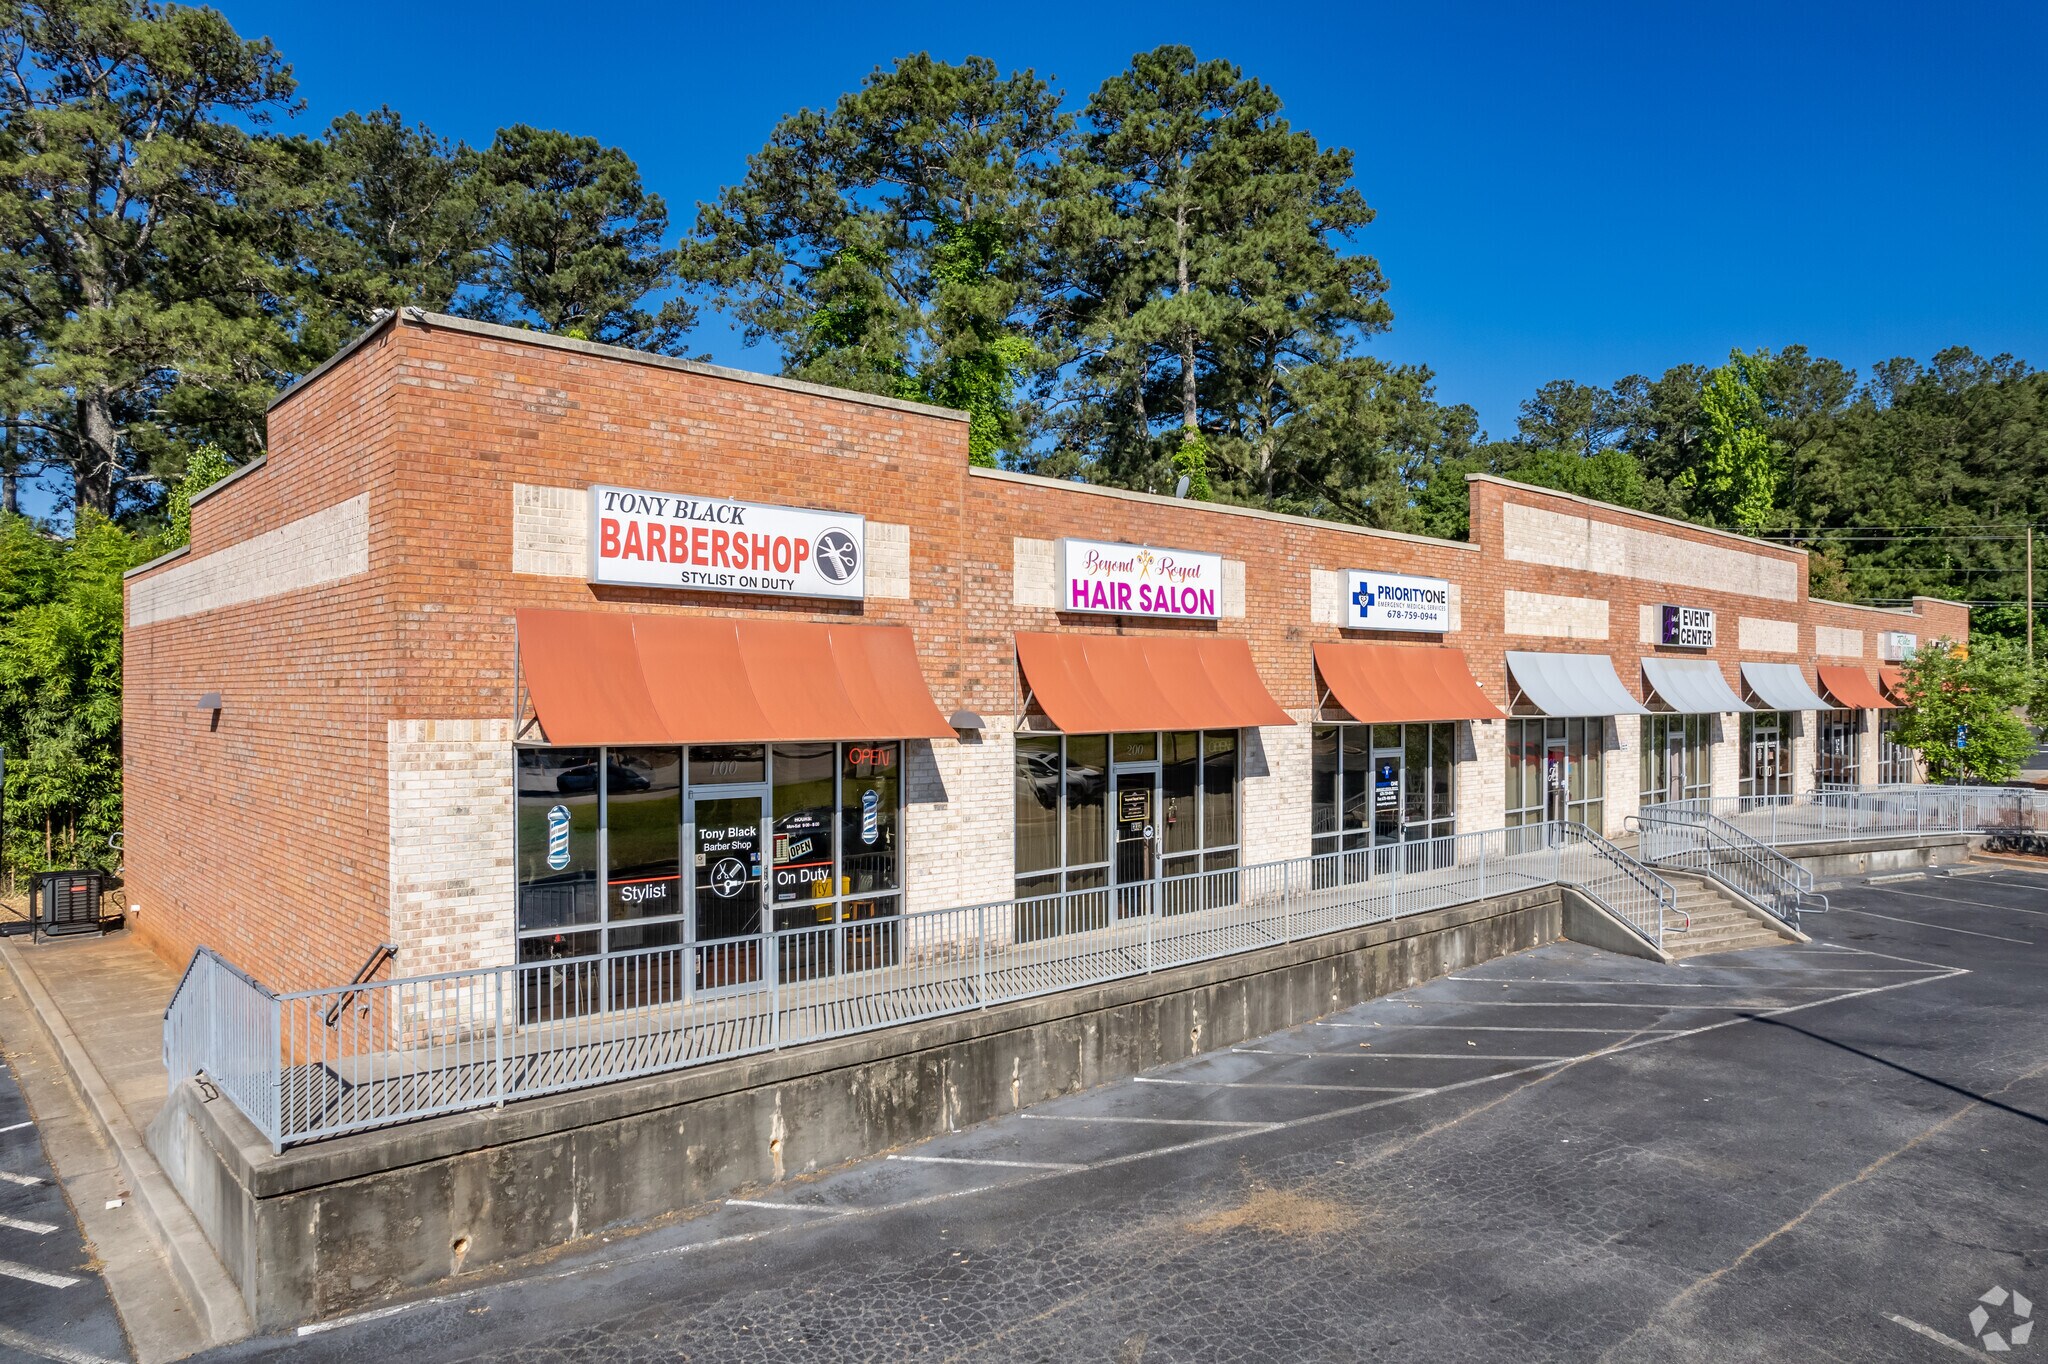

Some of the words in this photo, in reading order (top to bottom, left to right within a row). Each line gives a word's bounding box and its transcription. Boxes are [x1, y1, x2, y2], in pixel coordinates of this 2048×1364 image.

[604, 491, 670, 516] TONY
[673, 499, 747, 525] BLACK
[600, 517, 810, 574] BARBERSHOP
[1082, 549, 1135, 577] Beyond
[1155, 556, 1202, 583] Royal
[681, 571, 735, 588] STYLIST
[740, 575, 758, 588] ON
[761, 577, 795, 590] DUTY
[1072, 578, 1132, 611] HAIR
[1139, 583, 1215, 615] SALON
[1378, 585, 1445, 604] PRIORITYONE
[1387, 609, 1438, 621] 678-759-0944
[1683, 610, 1709, 628] EVENT
[1681, 628, 1711, 645] CENTER
[849, 747, 890, 766] OPEN
[1127, 744, 1144, 756] 200
[711, 760, 738, 776] 100
[699, 828, 725, 841] Tony
[728, 826, 756, 838] Black
[703, 842, 730, 852] Barber
[731, 840, 752, 850] Shop
[790, 840, 811, 857] OPEN
[777, 871, 796, 885] On
[800, 867, 829, 883] Duty
[621, 883, 667, 904] Stylist
